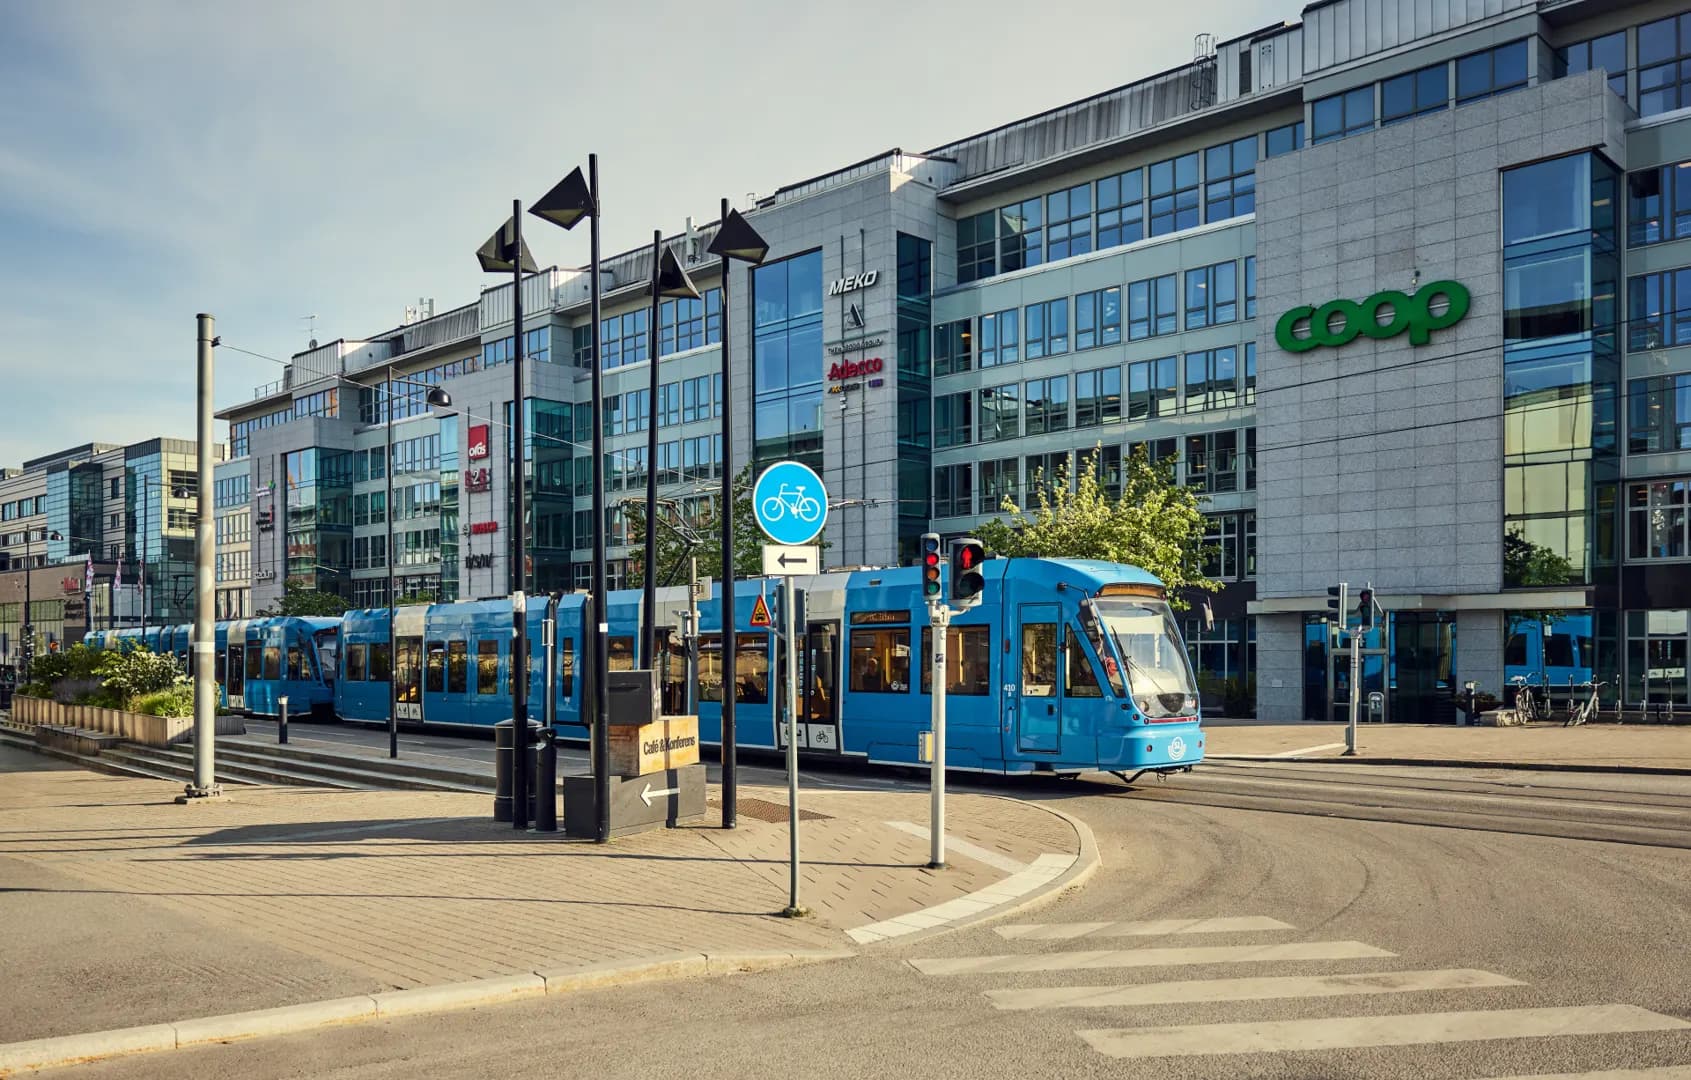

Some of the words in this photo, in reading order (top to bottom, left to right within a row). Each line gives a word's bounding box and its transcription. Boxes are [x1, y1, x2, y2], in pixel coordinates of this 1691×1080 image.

[828, 269, 879, 296] MEKO
[1275, 280, 1471, 353] coop
[827, 358, 884, 381] Adecco
[1003, 683, 1016, 692] 410
[643, 739, 659, 756] Café
[665, 735, 696, 752] Konferens
